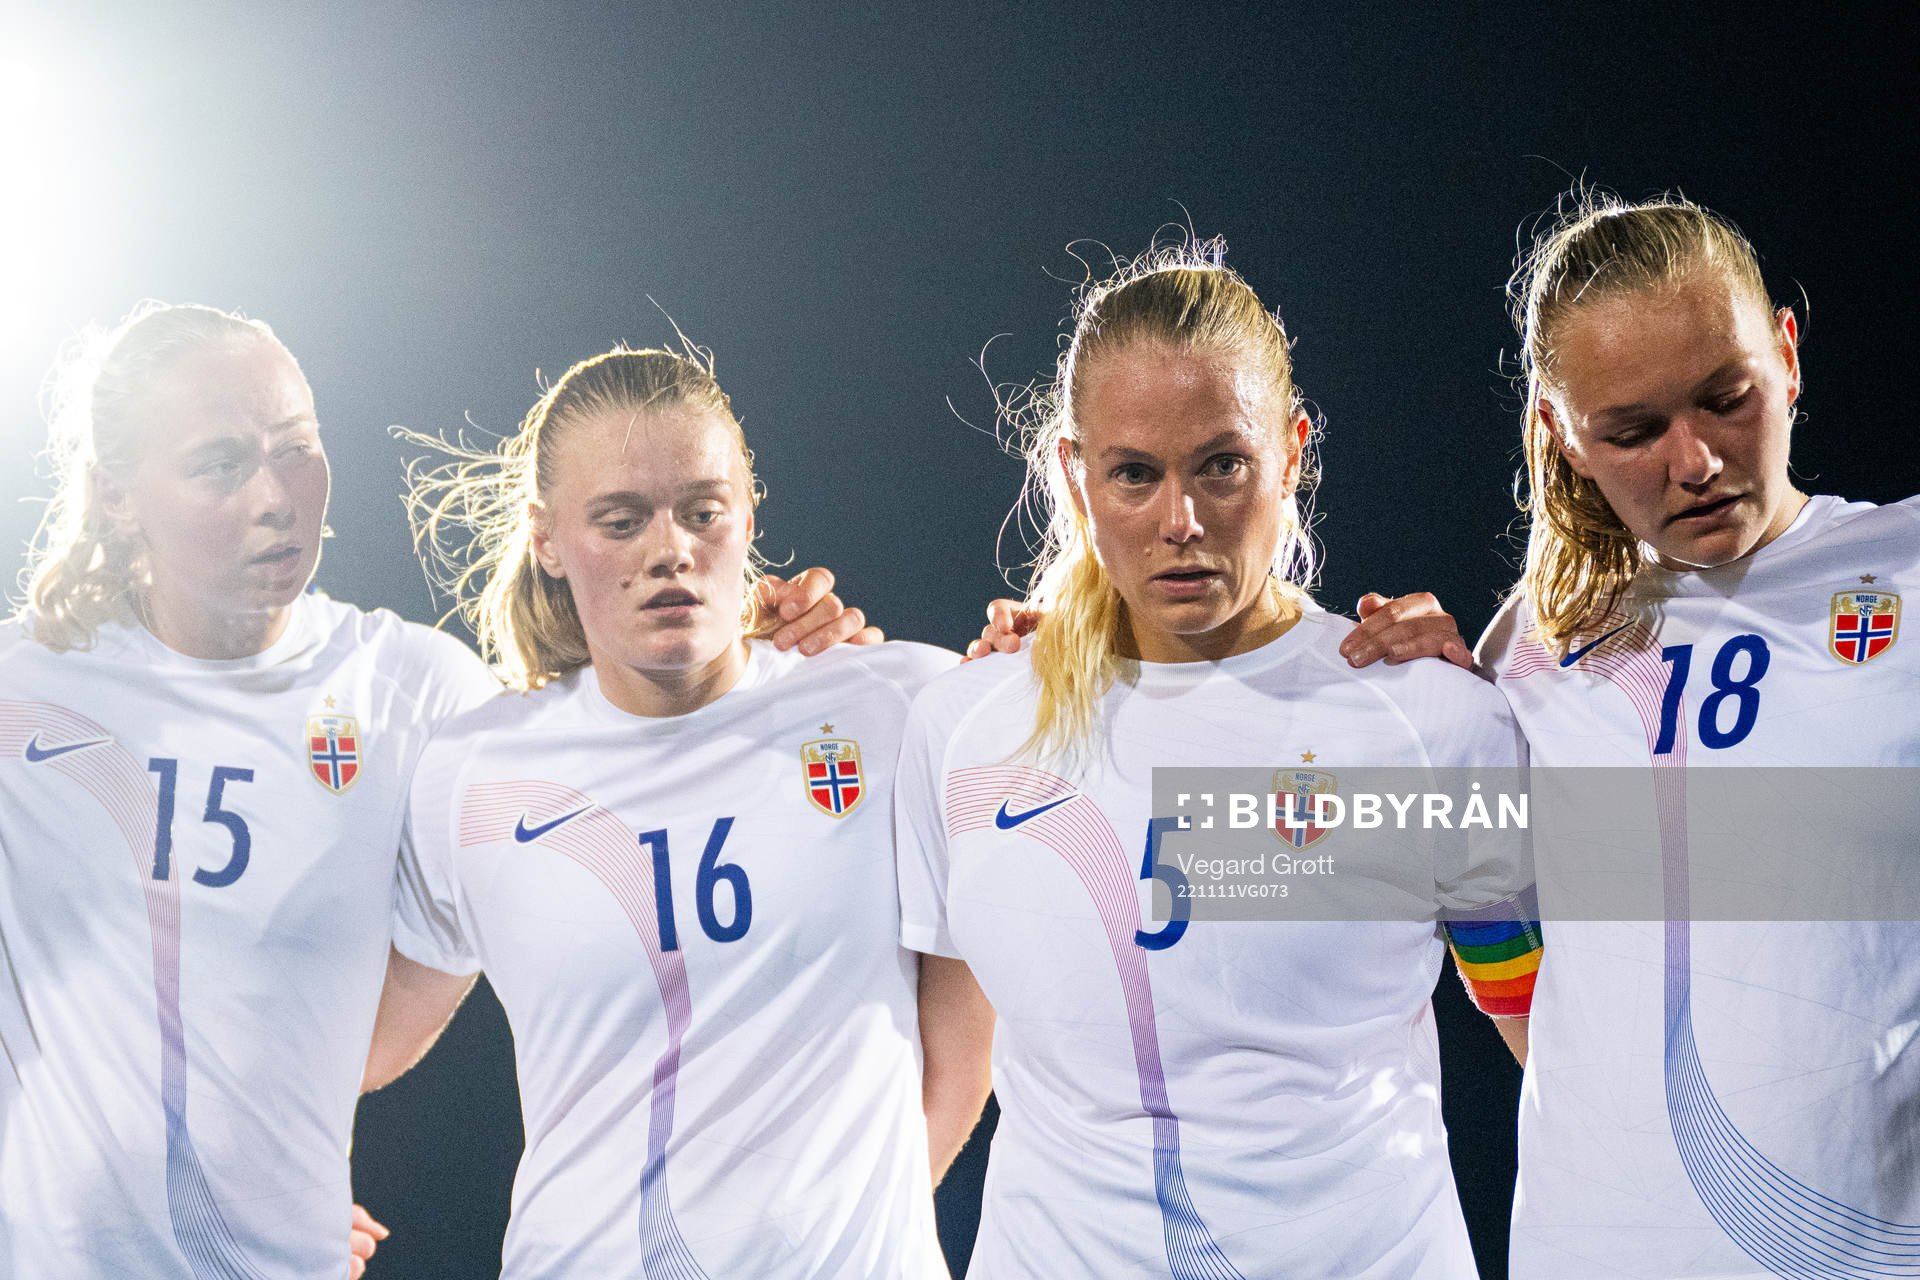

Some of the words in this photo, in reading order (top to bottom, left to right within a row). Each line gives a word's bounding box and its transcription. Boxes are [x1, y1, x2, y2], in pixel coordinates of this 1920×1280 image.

[1855, 594, 1878, 604] NORGE
[820, 743, 839, 751] NORGE
[1653, 634, 1771, 755] 18
[148, 758, 255, 888] 15
[1295, 772, 1316, 782] NORGE
[639, 816, 752, 952] 16
[1134, 816, 1192, 951] 5
